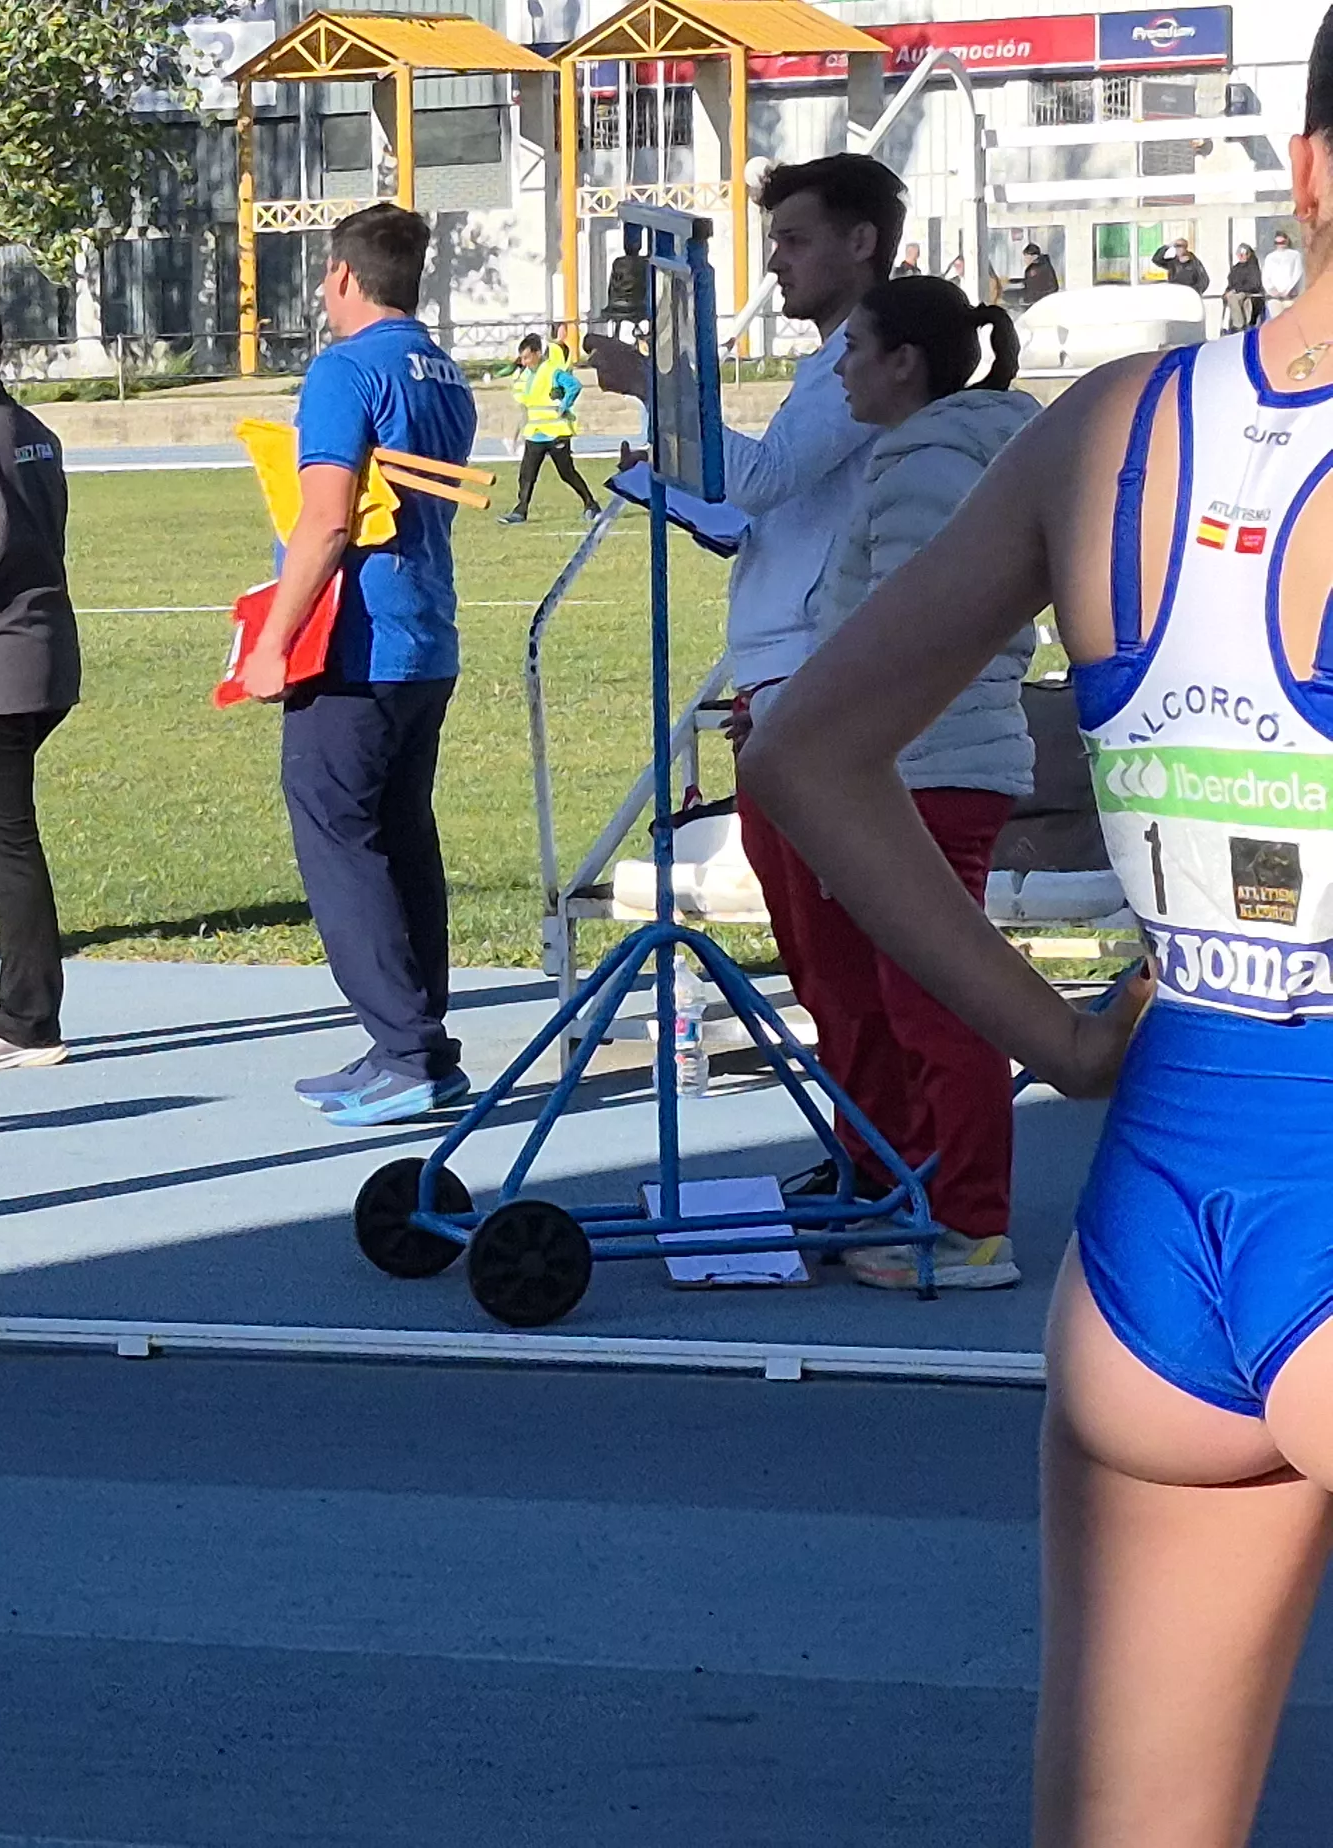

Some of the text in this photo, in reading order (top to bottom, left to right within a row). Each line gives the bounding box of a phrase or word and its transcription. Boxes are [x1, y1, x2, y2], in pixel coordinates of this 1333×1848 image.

[895, 38, 1032, 64] Aumoción
[407, 353, 466, 386] Jom
[1128, 685, 1296, 747] ALCORCÓ
[1172, 763, 1328, 812] Iberdrola
[1144, 821, 1168, 915] 1
